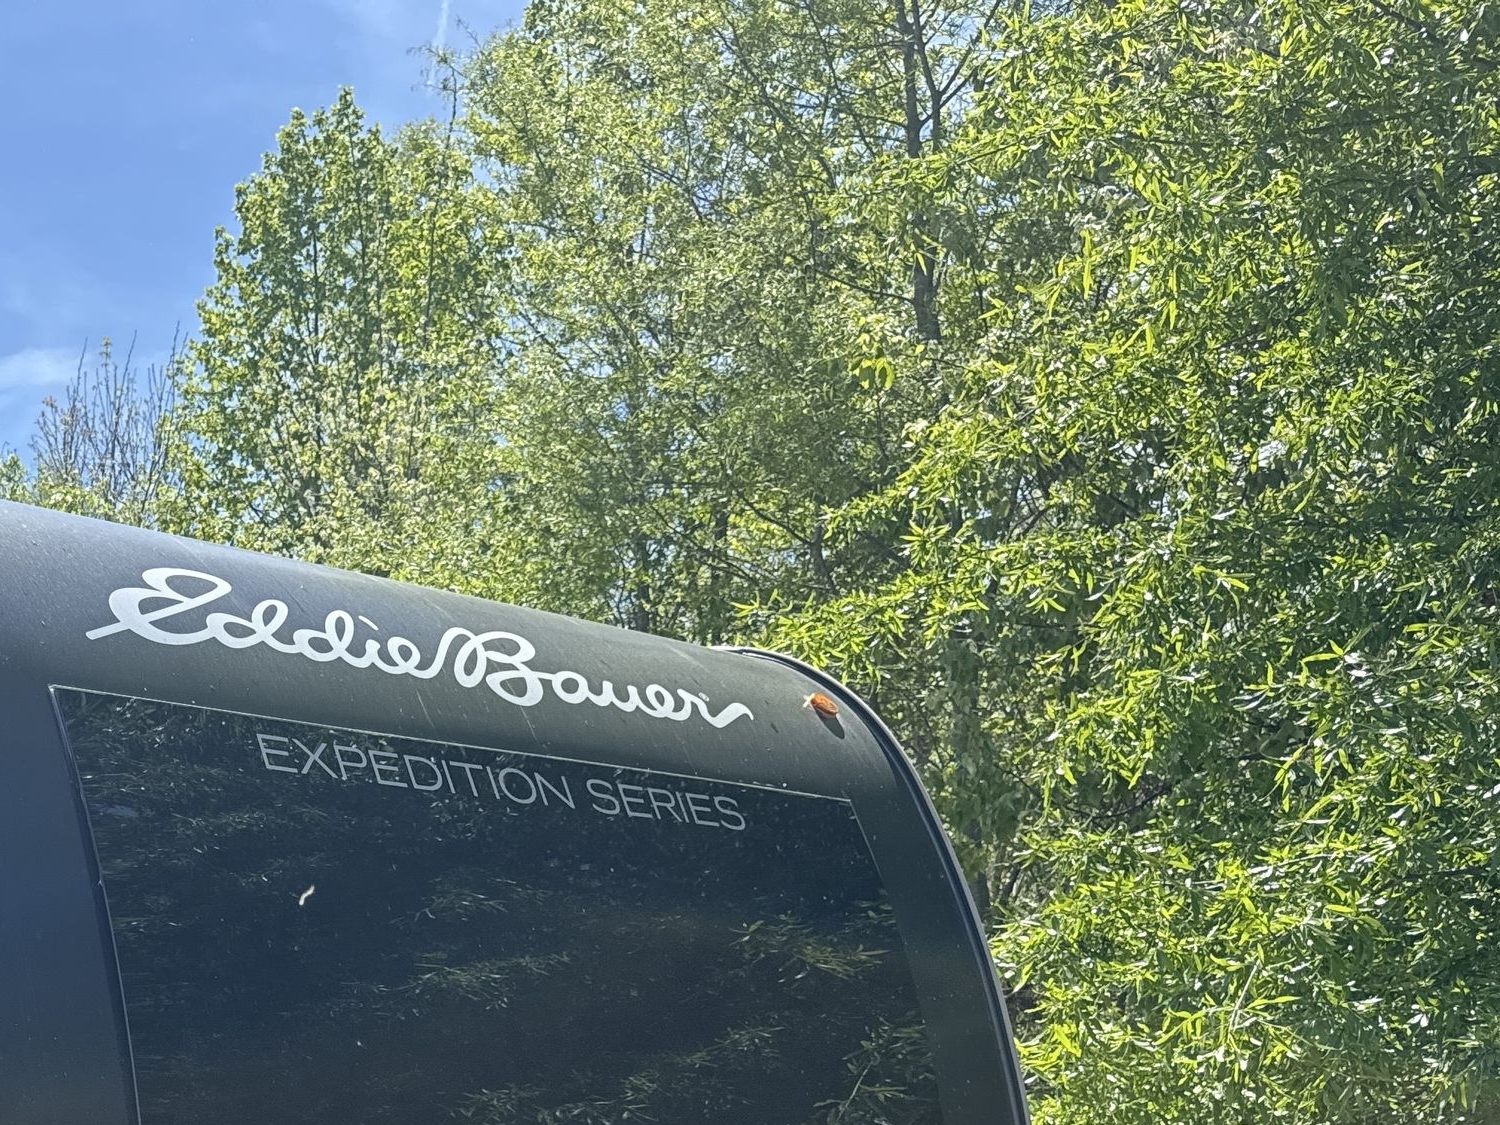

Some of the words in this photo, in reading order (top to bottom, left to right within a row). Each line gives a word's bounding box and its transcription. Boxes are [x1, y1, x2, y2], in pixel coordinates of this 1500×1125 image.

[86, 568, 435, 678] Eddie
[430, 626, 752, 728] Bauer
[256, 732, 574, 808] EXPEDITION
[586, 779, 746, 830] SERIES
